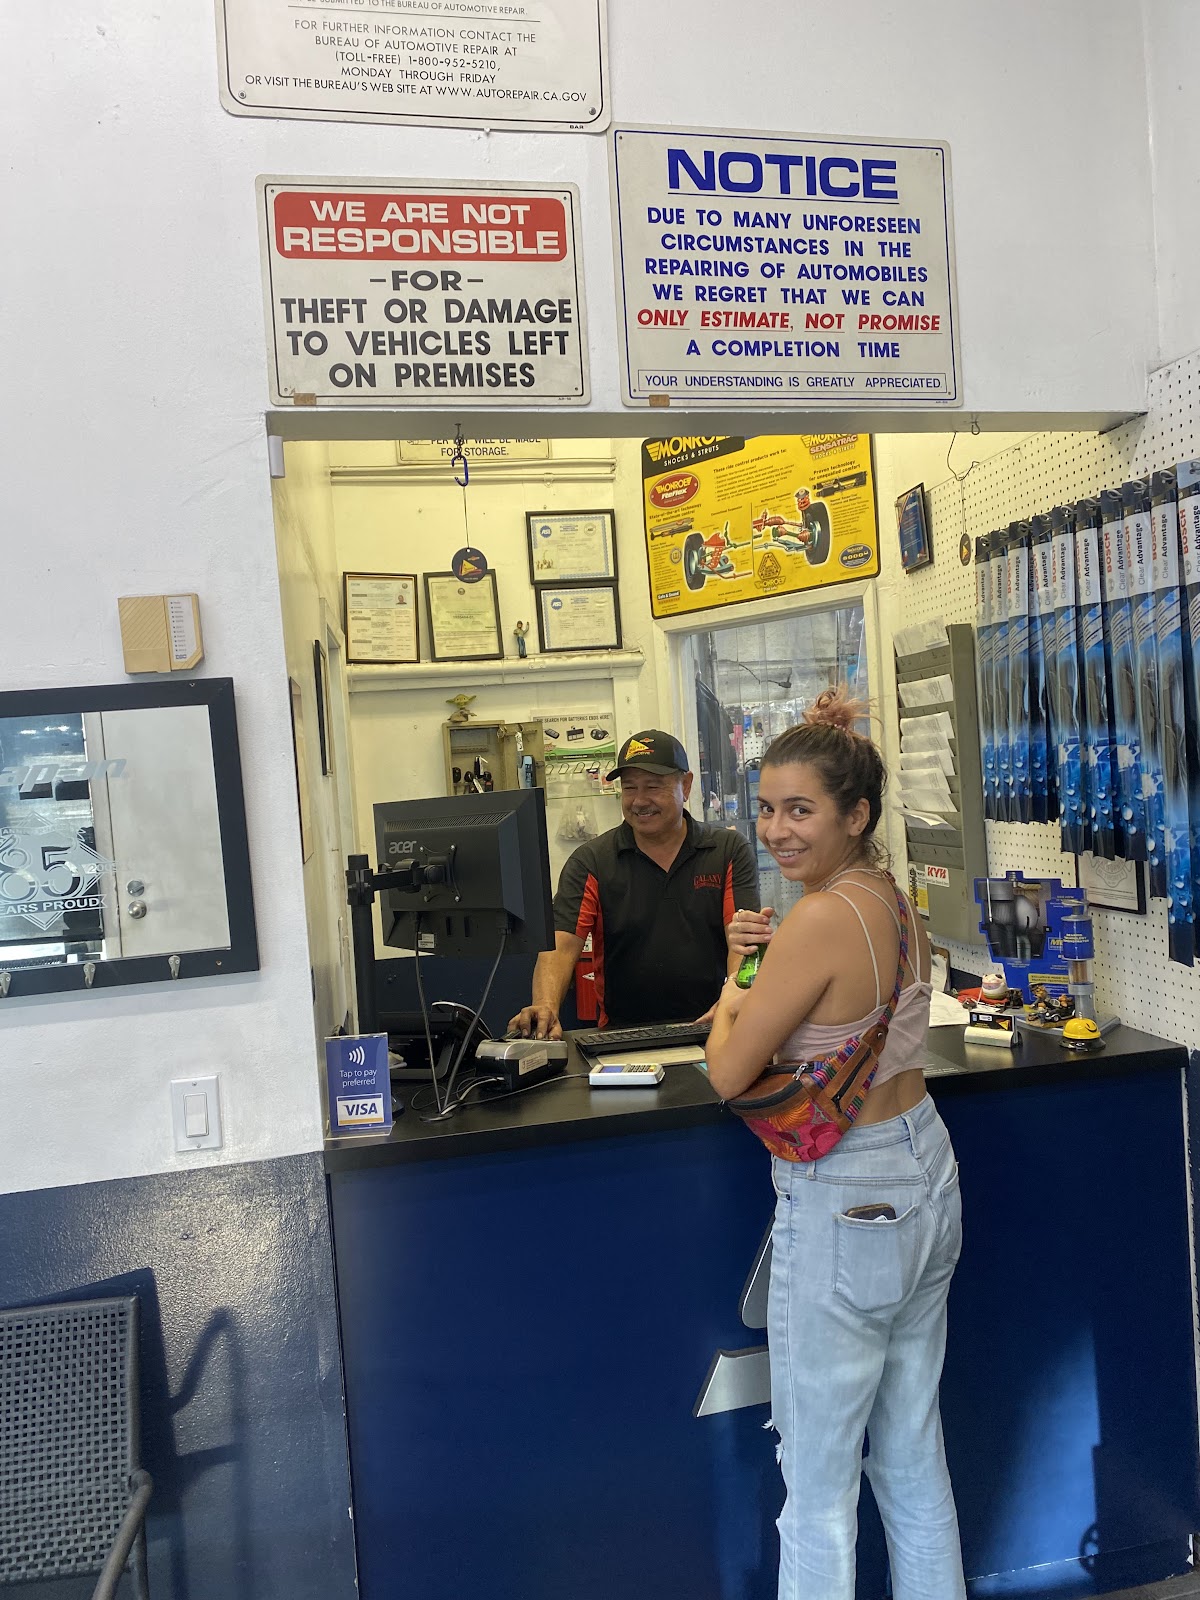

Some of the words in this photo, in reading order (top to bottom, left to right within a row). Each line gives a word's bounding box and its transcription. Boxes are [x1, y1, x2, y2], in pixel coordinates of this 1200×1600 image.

[381, 0, 396, 8] THE
[397, 1, 430, 10] BUREAU
[444, 3, 498, 13] AUTOMOTIVE
[294, 20, 317, 30] FOR
[323, 22, 370, 34] FURTHER
[374, 25, 455, 39] INFORMATION
[459, 30, 512, 42] CONTACT
[517, 33, 536, 43] THE
[315, 36, 359, 48] BUREAU
[364, 38, 380, 49] OF
[384, 40, 458, 54] AUTOMOTIVE
[463, 45, 499, 56] REPAIR
[504, 47, 518, 56] AT
[335, 51, 401, 65] (TOLL-FREE)
[408, 55, 501, 71] 1-800-952-5210,
[341, 66, 392, 78] MONDAY
[399, 70, 454, 82] THROUGH
[460, 73, 496, 84] FRIDAY
[245, 75, 261, 85] OR
[264, 76, 289, 87] VISIT
[292, 78, 312, 88] THE
[314, 79, 368, 91] BUREAU'S
[369, 82, 393, 93] WEB
[396, 84, 416, 94] SITE
[419, 85, 432, 95] AT
[435, 87, 587, 102] WWW.AUTOREPAIR.CA.GOV
[667, 149, 898, 199] NOTICE
[309, 200, 365, 222] WE
[381, 202, 449, 223] ARE
[463, 204, 530, 225] NOT
[647, 207, 685, 225] DUE
[696, 209, 722, 227] TO
[733, 212, 791, 230] MANY
[803, 214, 921, 234] UNFORESEEN
[283, 227, 560, 255] RESPONSIBLE
[661, 233, 829, 256] CIRCUMSTANCES
[845, 241, 864, 257] IN
[878, 241, 911, 258] THE
[645, 258, 749, 278] REPAIRING
[760, 262, 785, 278] OF
[797, 264, 928, 283] AUTOMOBILES
[652, 284, 683, 301] WE
[695, 285, 767, 304] REGRET
[780, 288, 827, 305] THAT
[842, 289, 870, 306] WE
[882, 290, 924, 307] CAN
[280, 298, 367, 323] THEFT
[384, 298, 428, 323] OR
[445, 298, 572, 323] DAMAGE
[637, 309, 689, 327] ONLY
[700, 311, 794, 332] ESTIMATE,
[805, 313, 845, 330] NOT
[858, 314, 940, 331] PROMISE
[287, 330, 328, 356] TO
[345, 330, 490, 356] VEHICLES
[508, 331, 569, 356] LEFT
[686, 340, 701, 356] A
[711, 340, 840, 357] COMPLETION
[857, 342, 900, 358] TIME
[329, 363, 376, 388] ON
[395, 363, 535, 388] PREMISES
[645, 376, 678, 387] YOUR
[685, 376, 783, 388] UNDERSTANDING
[789, 377, 800, 387] IS
[806, 377, 855, 388] GREATLY
[441, 447, 461, 456] FOR
[464, 447, 509, 456] STORAGE.
[663, 455, 689, 467] SHOCKS
[697, 444, 720, 457] STRUTS
[735, 459, 750, 467] control
[750, 454, 769, 463] products
[831, 460, 856, 470] technology
[842, 464, 861, 472] comfort
[657, 477, 691, 493] MONROE
[1180, 509, 1188, 554] BOSCH
[1104, 532, 1112, 573] BOSCH
[389, 840, 417, 854] acer
[43, 898, 100, 912] PROUD
[340, 1070, 352, 1078] Tap
[354, 1069, 362, 1077] to
[364, 1069, 377, 1078] pay
[342, 1077, 376, 1088] preferred
[343, 1103, 378, 1116] VISA
